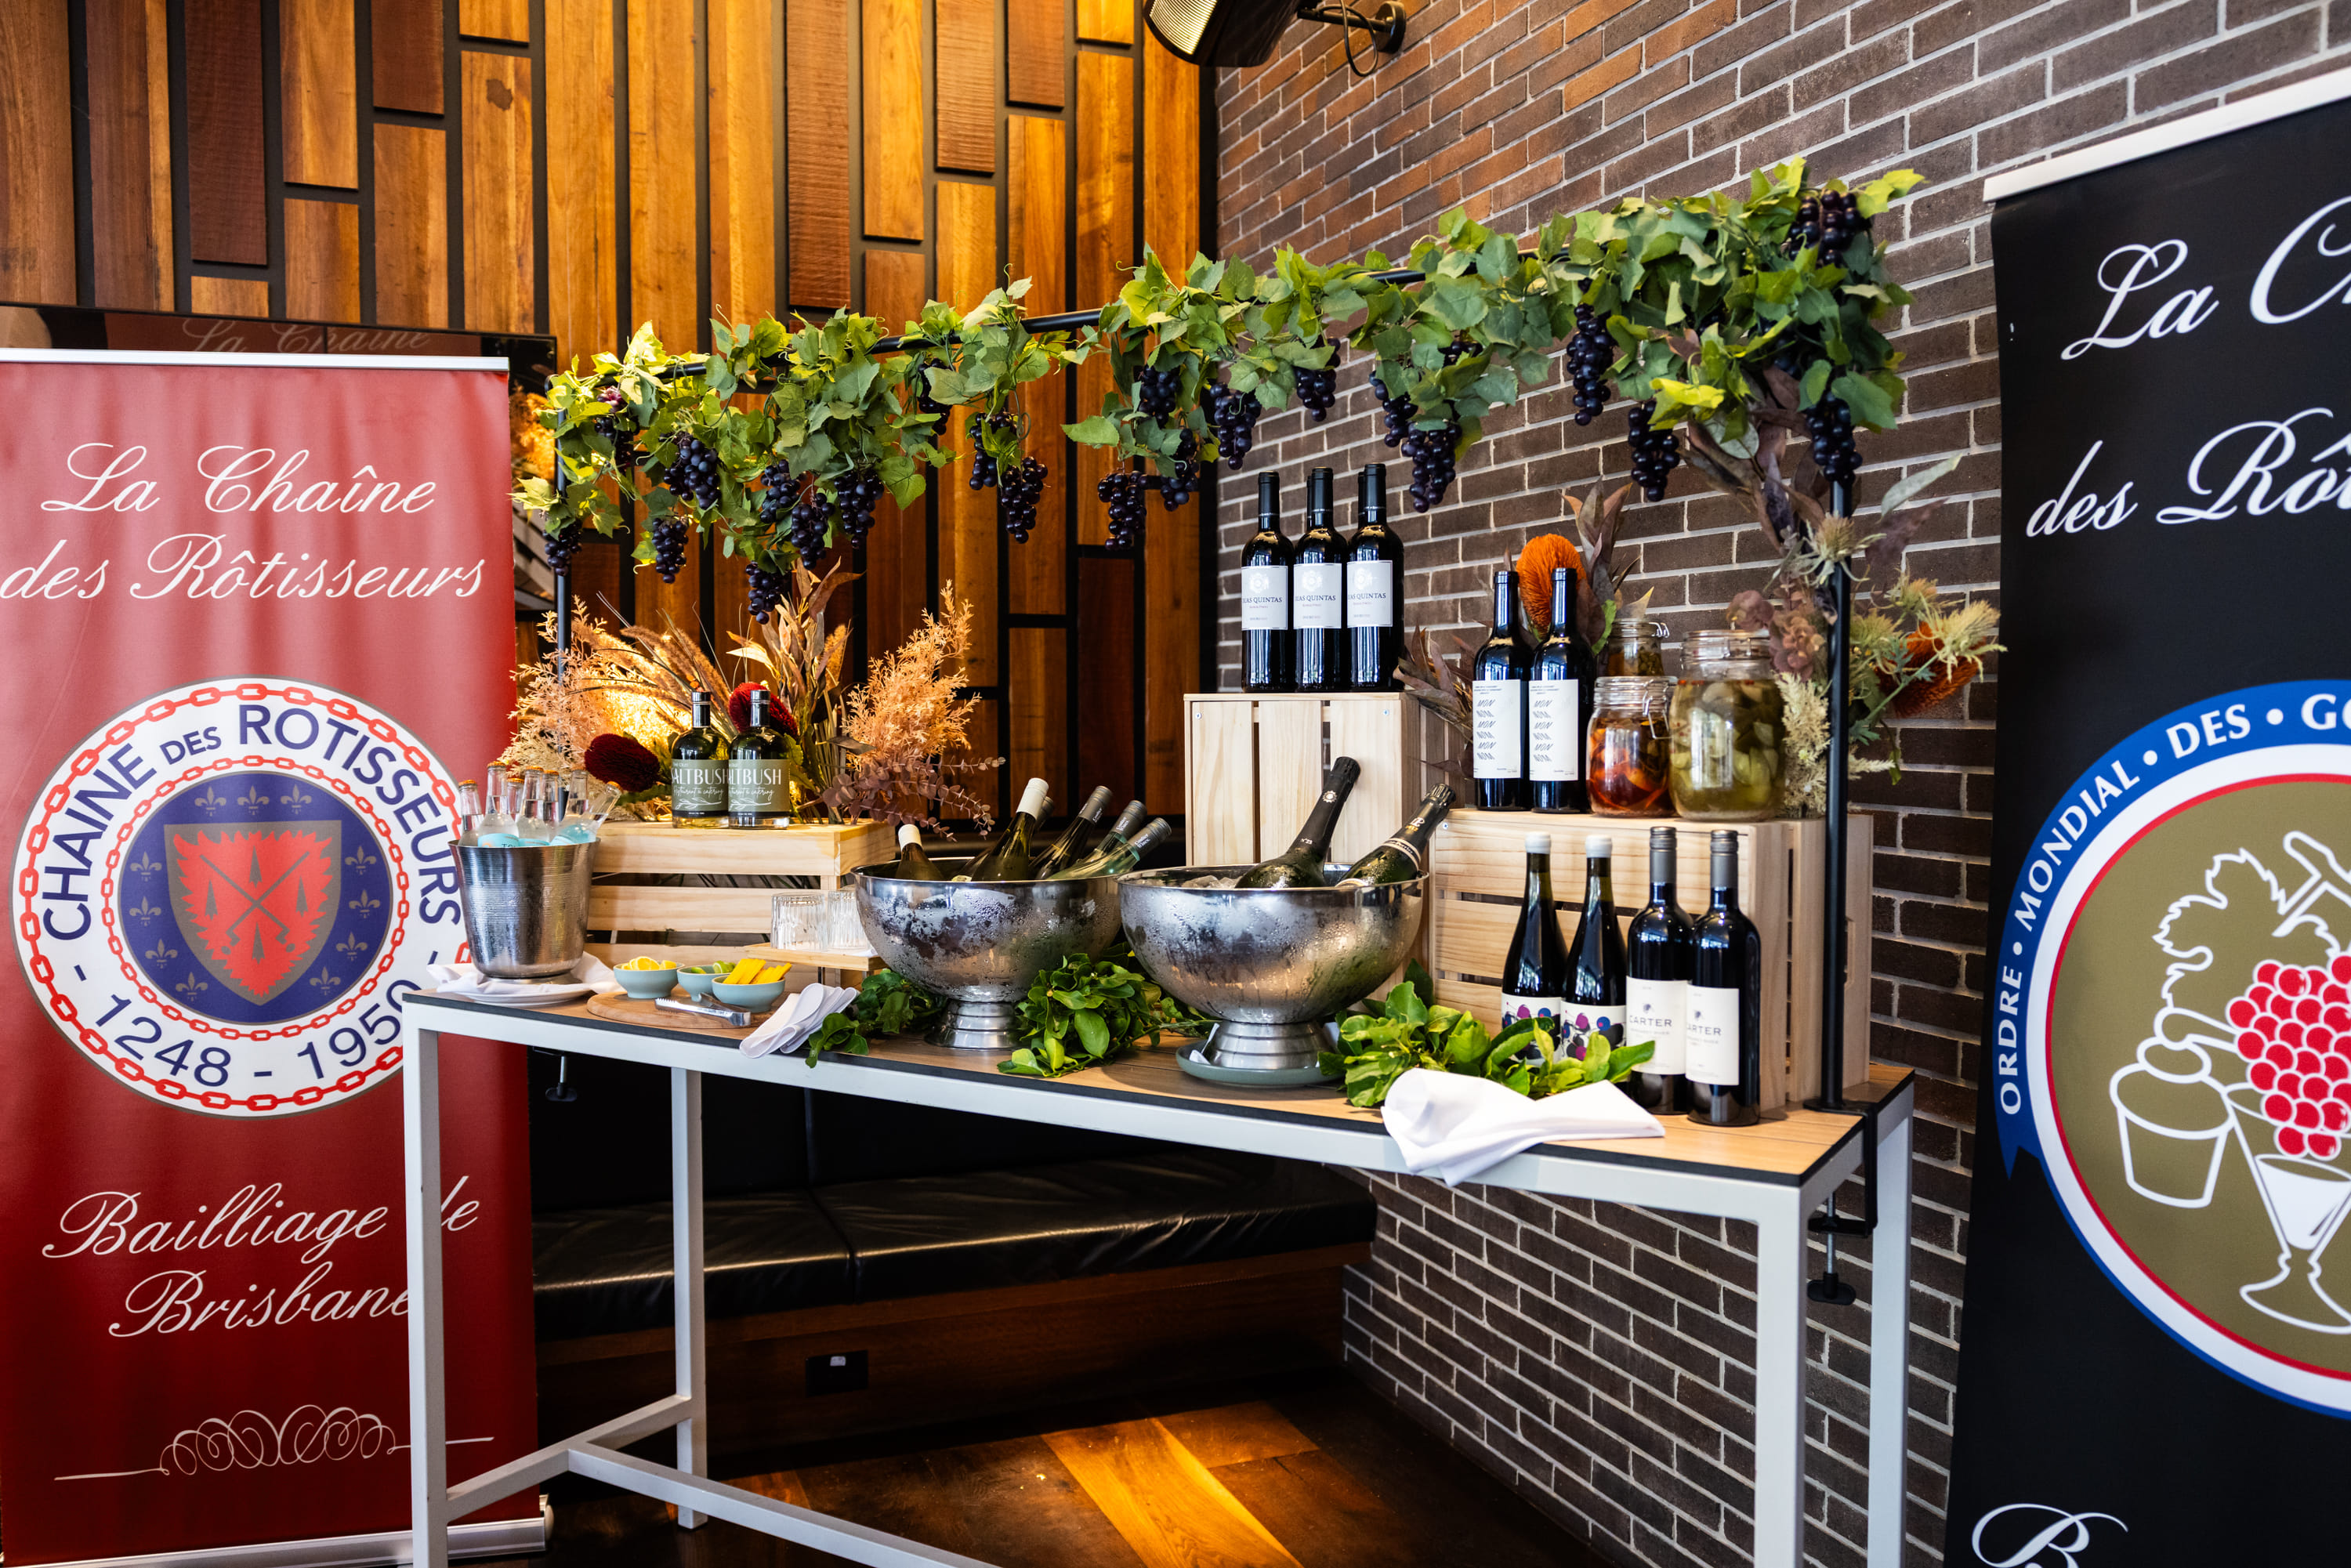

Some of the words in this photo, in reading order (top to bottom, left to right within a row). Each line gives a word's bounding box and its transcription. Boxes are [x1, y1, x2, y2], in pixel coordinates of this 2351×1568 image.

[2061, 238, 2219, 360] La
[2250, 196, 2351, 324] C
[41, 443, 161, 512] La
[197, 445, 437, 513] Chaîne
[2027, 440, 2138, 537] des
[2156, 407, 2351, 524] Rô
[0, 539, 109, 599] des
[130, 534, 485, 599] Rôtisseurs
[671, 768, 729, 784] SALTBUSH
[752, 786, 774, 801] catering
[42, 744, 157, 940] CHAINE
[159, 726, 223, 765] DES
[239, 704, 461, 926] ROTISSEURS
[1998, 965, 2023, 1114] ORDRE
[2014, 760, 2140, 932] MONDIAL
[2165, 704, 2251, 759] DES
[2300, 693, 2351, 730] G
[95, 994, 231, 1087] 1248
[1687, 1023, 1722, 1036] ARTER
[42, 1182, 389, 1264] Bailliage
[109, 1261, 409, 1338] Brisbane
